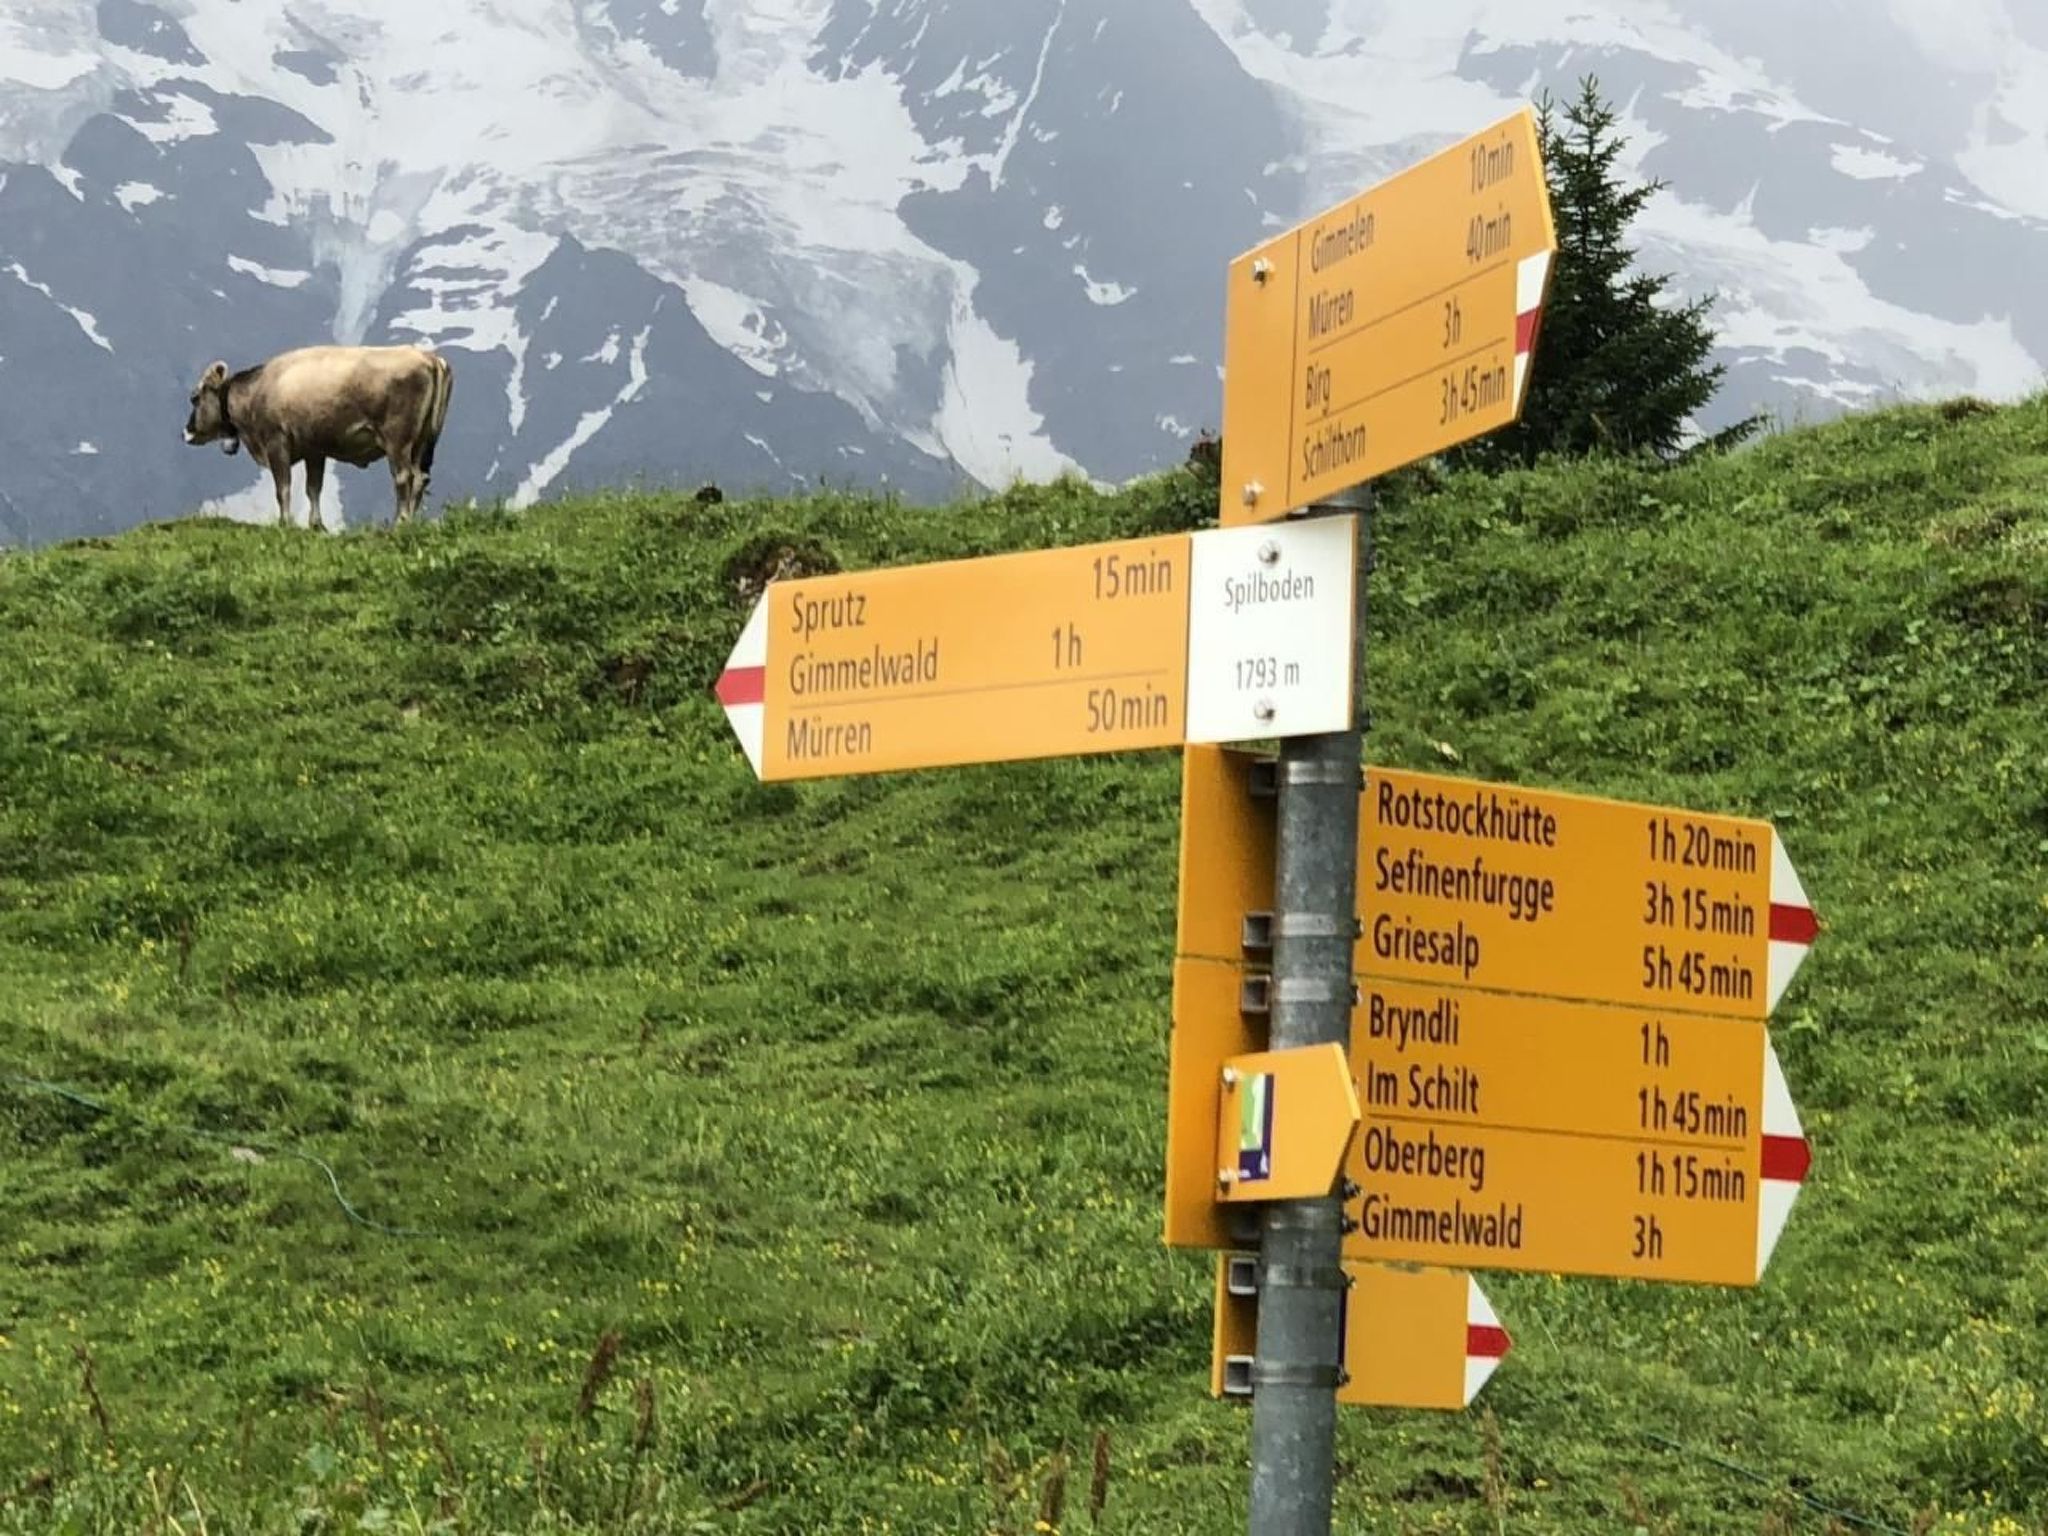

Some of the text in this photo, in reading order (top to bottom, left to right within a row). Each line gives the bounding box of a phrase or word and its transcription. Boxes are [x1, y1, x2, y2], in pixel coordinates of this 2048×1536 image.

[1311, 207, 1375, 274] Gimmelen
[1309, 288, 1354, 339] Mürren
[1305, 363, 1330, 415] Birg
[1302, 422, 1366, 481] Schilthorn
[791, 591, 866, 638] Sprutz
[1225, 571, 1314, 609] Spilboden
[789, 638, 939, 695] Gimmelwald
[1235, 657, 1300, 689] 1793 m
[787, 716, 871, 760] Mürren
[1377, 780, 1557, 848] Rotstockhütte
[1376, 847, 1554, 922] Sefinenfurgge
[1374, 913, 1479, 979] Griesalp
[1370, 993, 1459, 1052] Bryndli
[1367, 1060, 1397, 1107] Im
[1408, 1064, 1479, 1115] Schilt
[1365, 1127, 1485, 1191] Oberberg
[1362, 1195, 1522, 1249] Gimmelwald
